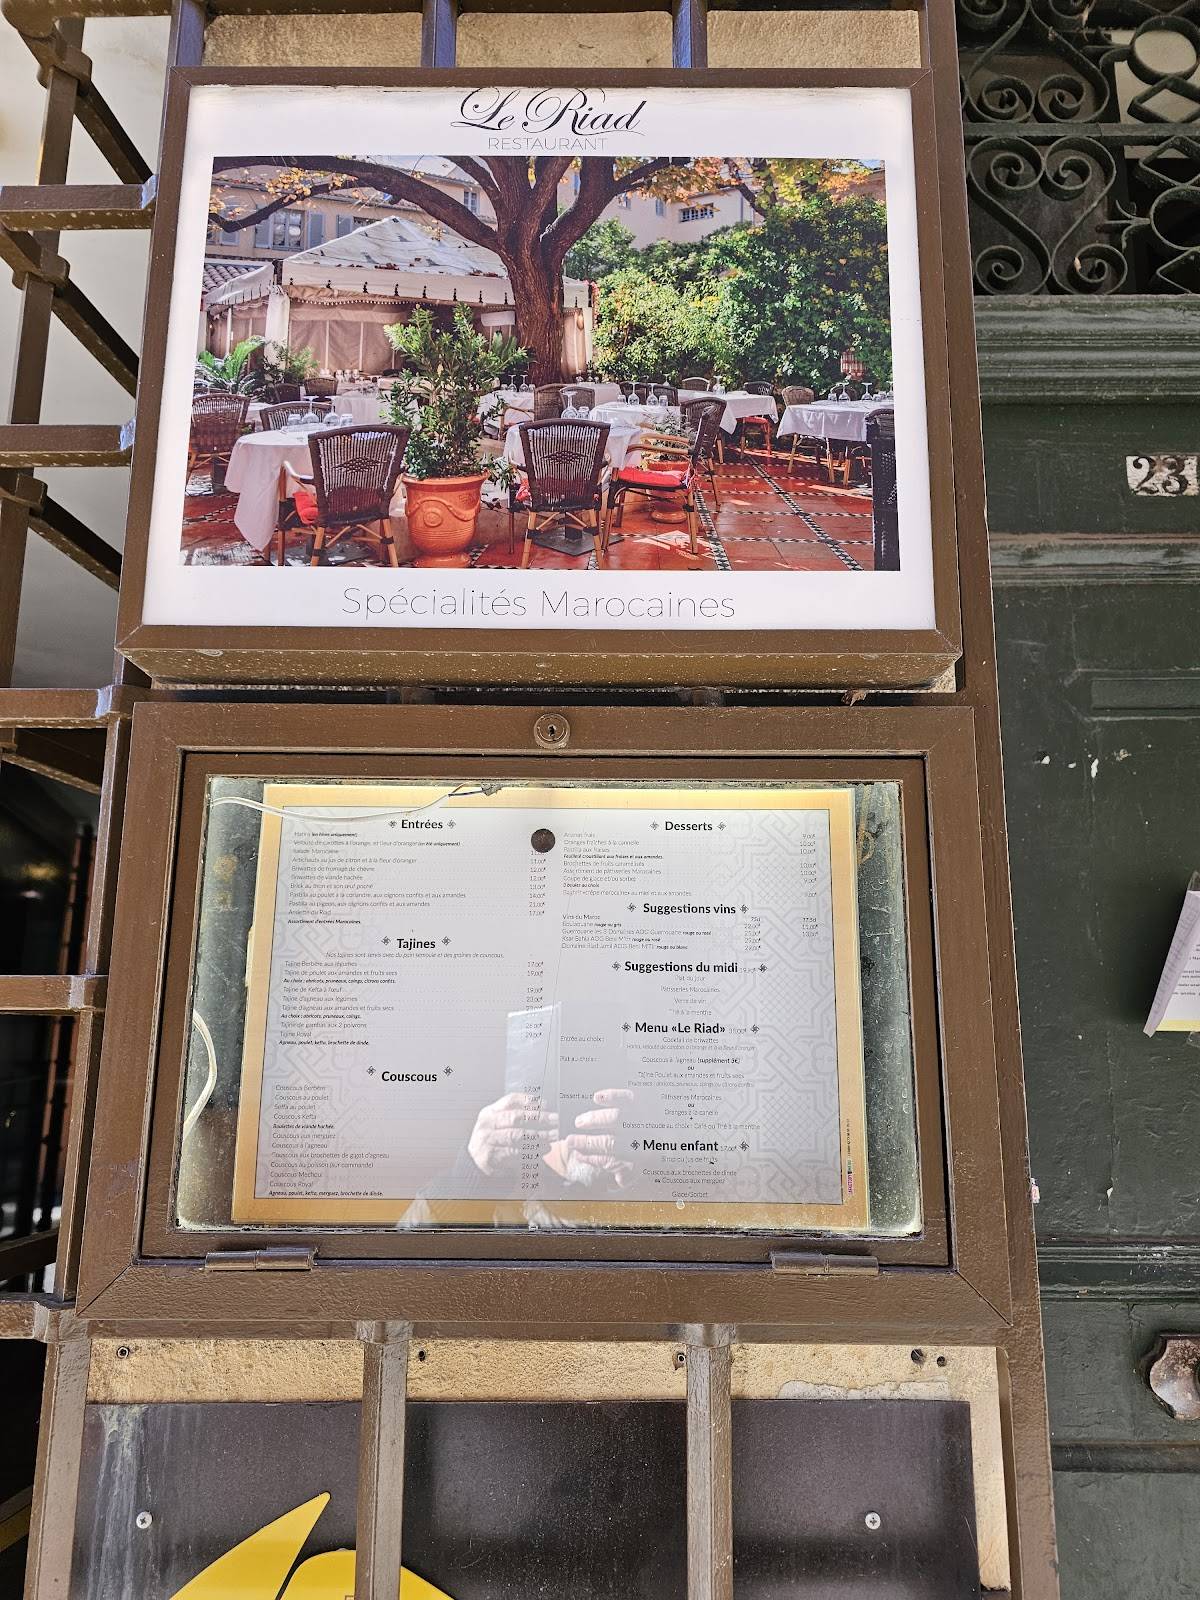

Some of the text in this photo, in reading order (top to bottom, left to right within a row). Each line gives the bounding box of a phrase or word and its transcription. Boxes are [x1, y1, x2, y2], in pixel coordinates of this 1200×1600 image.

[451, 87, 648, 136] Le Riad
[488, 138, 608, 151] RESTAURANT
[1133, 457, 1189, 495] 23
[342, 586, 735, 620] Spécialités Marocaines
[401, 819, 443, 830] Entrées
[664, 820, 712, 831] Desserts
[643, 903, 736, 916] Suggestions vins
[396, 938, 436, 951] Tajines
[624, 961, 738, 974] Suggestions du midi
[635, 1022, 668, 1033] Menu
[672, 1023, 692, 1034] «Le
[694, 1023, 726, 1034] Riad»
[381, 1071, 438, 1082] Couscous
[643, 1139, 718, 1152] Menu enfant
